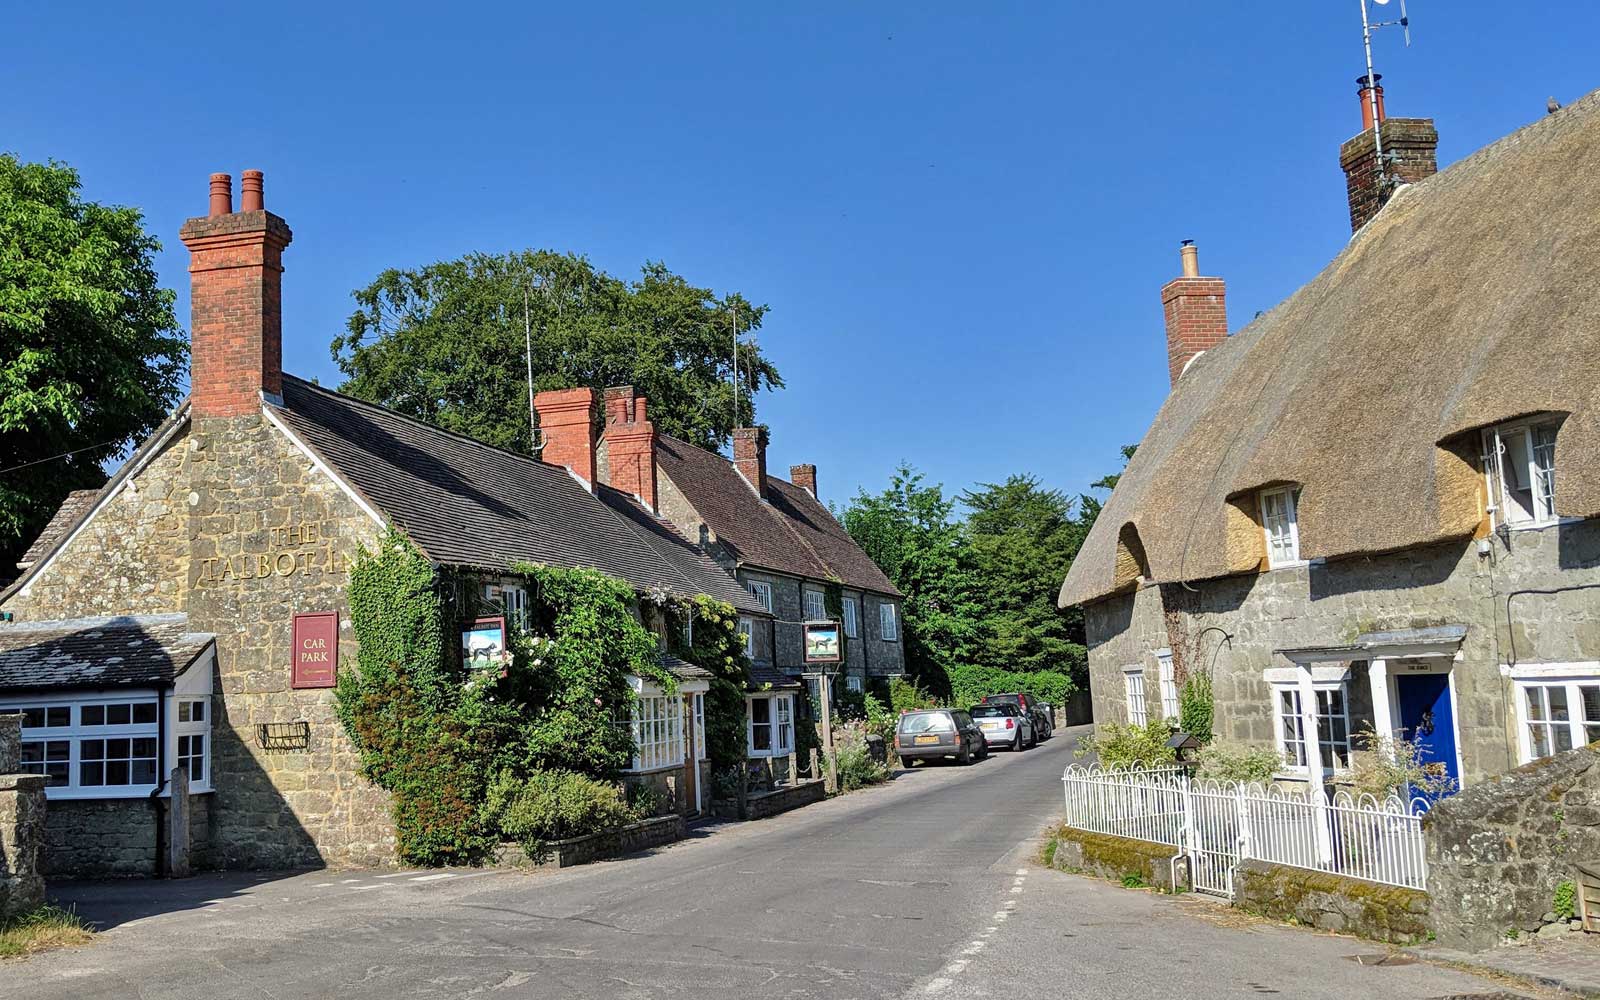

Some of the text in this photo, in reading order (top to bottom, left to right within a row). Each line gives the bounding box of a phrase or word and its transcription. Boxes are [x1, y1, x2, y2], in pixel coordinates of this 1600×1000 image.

[272, 524, 316, 546] THE
[203, 549, 357, 581] TALBOT IN
[303, 638, 326, 649] CAR
[301, 651, 328, 663] PARK
